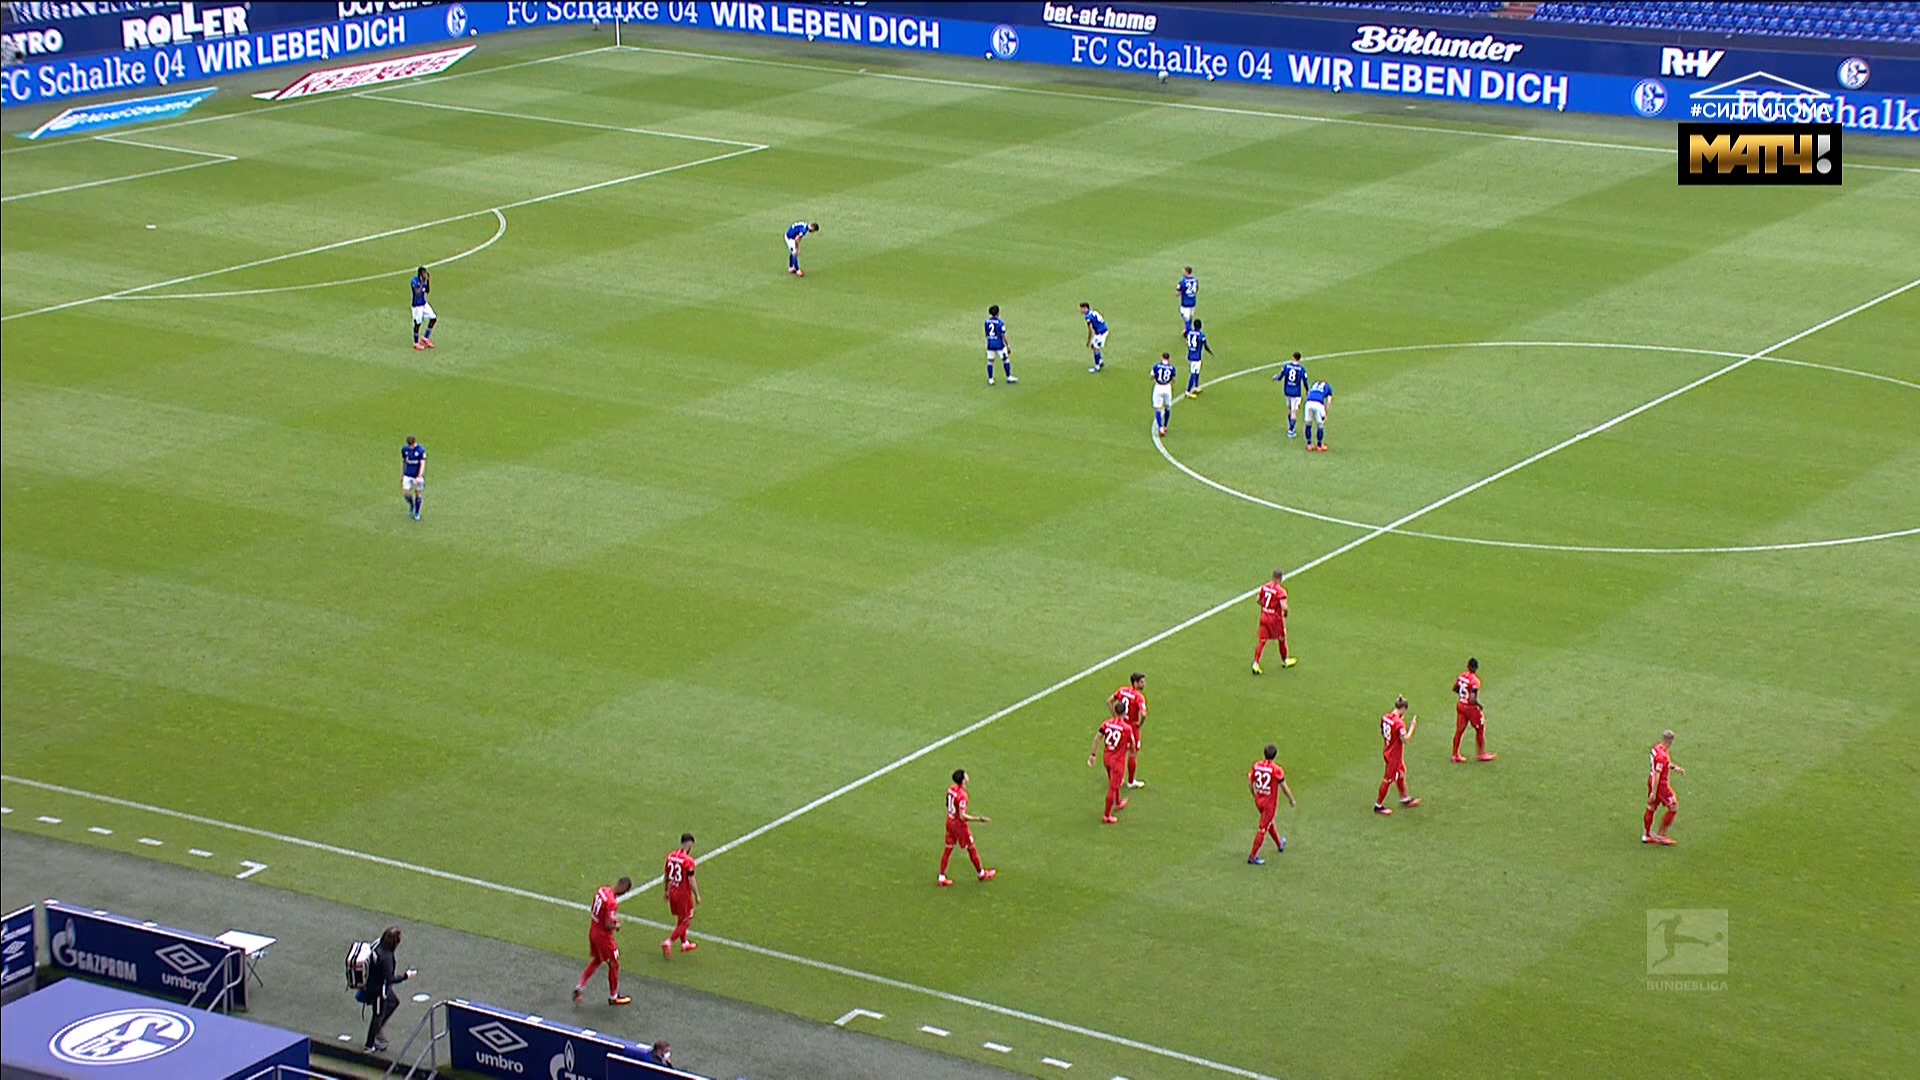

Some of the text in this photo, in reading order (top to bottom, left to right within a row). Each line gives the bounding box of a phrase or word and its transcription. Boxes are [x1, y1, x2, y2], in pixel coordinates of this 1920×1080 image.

[122, 2, 249, 49] ROLLER
[710, 2, 940, 48] WIR LEBEN DICH
[1043, 2, 1157, 31] bet-at-home
[197, 15, 406, 73] WIR LEBEN DICH
[1351, 25, 1523, 62] Böklunder
[1072, 34, 1273, 80] FC Schalke 04
[1661, 47, 1724, 77] R+V
[38, 55, 146, 96] Schalke
[153, 49, 185, 84] 04
[1288, 54, 1568, 107] WIR LEBEN DICH
[988, 323, 996, 336] 2
[1157, 367, 1172, 381] 18
[1288, 368, 1297, 382] 8
[1264, 591, 1272, 608] 7
[1105, 728, 1121, 747] 29
[1255, 771, 1271, 790] 32
[667, 862, 682, 882] 23
[161, 972, 207, 993] umbro
[476, 1050, 524, 1074] umbro
